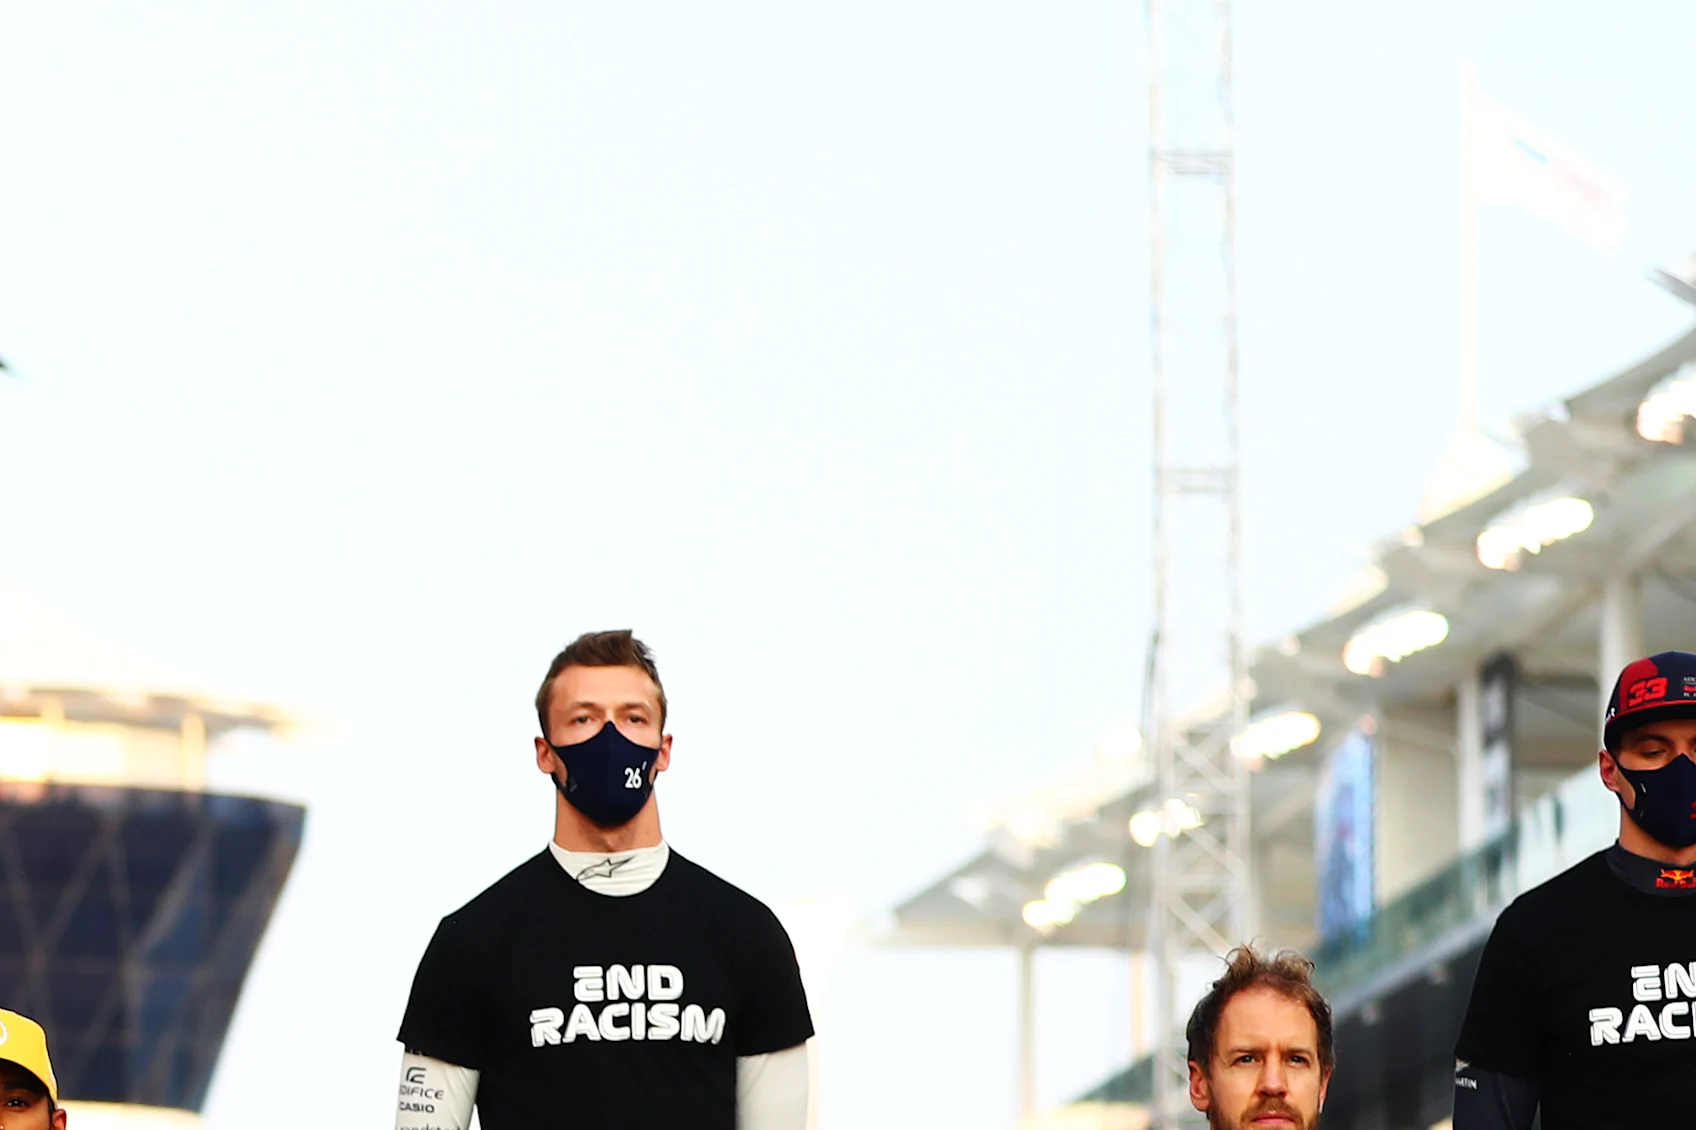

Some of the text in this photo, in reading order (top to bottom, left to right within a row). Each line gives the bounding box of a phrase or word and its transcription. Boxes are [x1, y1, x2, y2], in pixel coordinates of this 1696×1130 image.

[1628, 677, 1669, 707] 33
[624, 767, 642, 789] 26
[573, 963, 684, 1003] END
[529, 1002, 726, 1048] RACISM
[399, 1101, 435, 1113] CASIO
